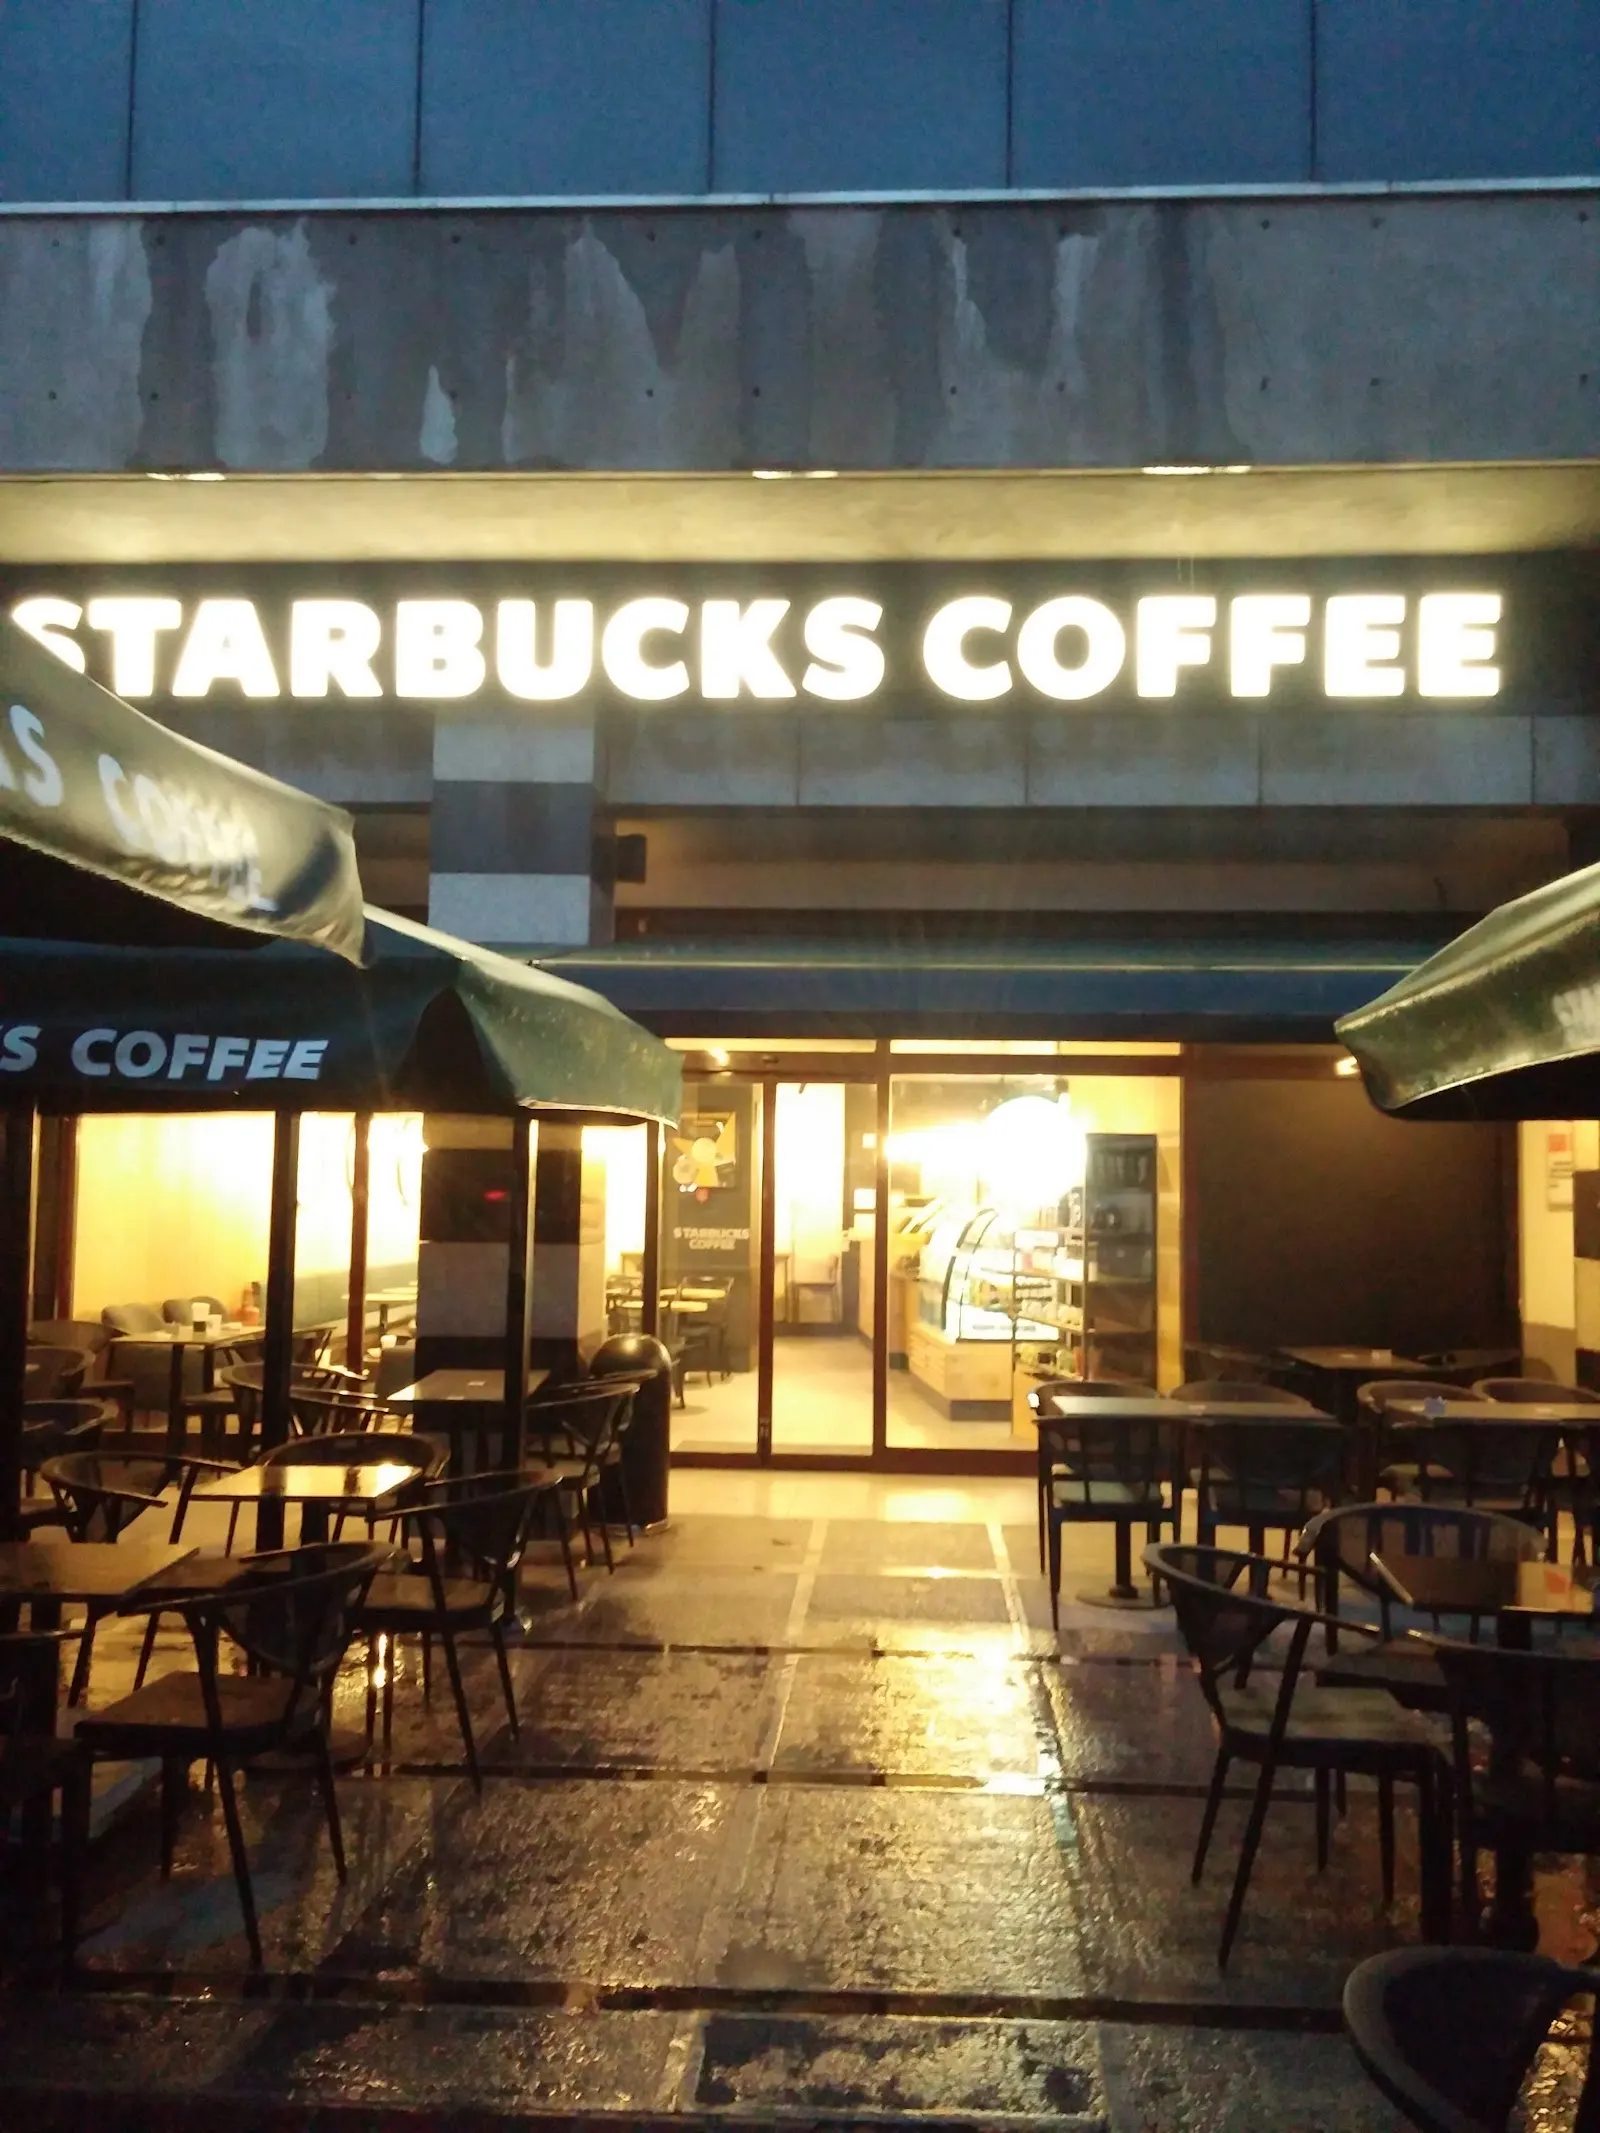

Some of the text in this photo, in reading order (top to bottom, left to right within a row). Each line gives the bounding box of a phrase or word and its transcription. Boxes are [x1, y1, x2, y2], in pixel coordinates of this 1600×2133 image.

[12, 596, 1502, 700] STARBUCKS COFFEE
[0, 704, 64, 807] S
[0, 1025, 329, 1081] S COFFEE
